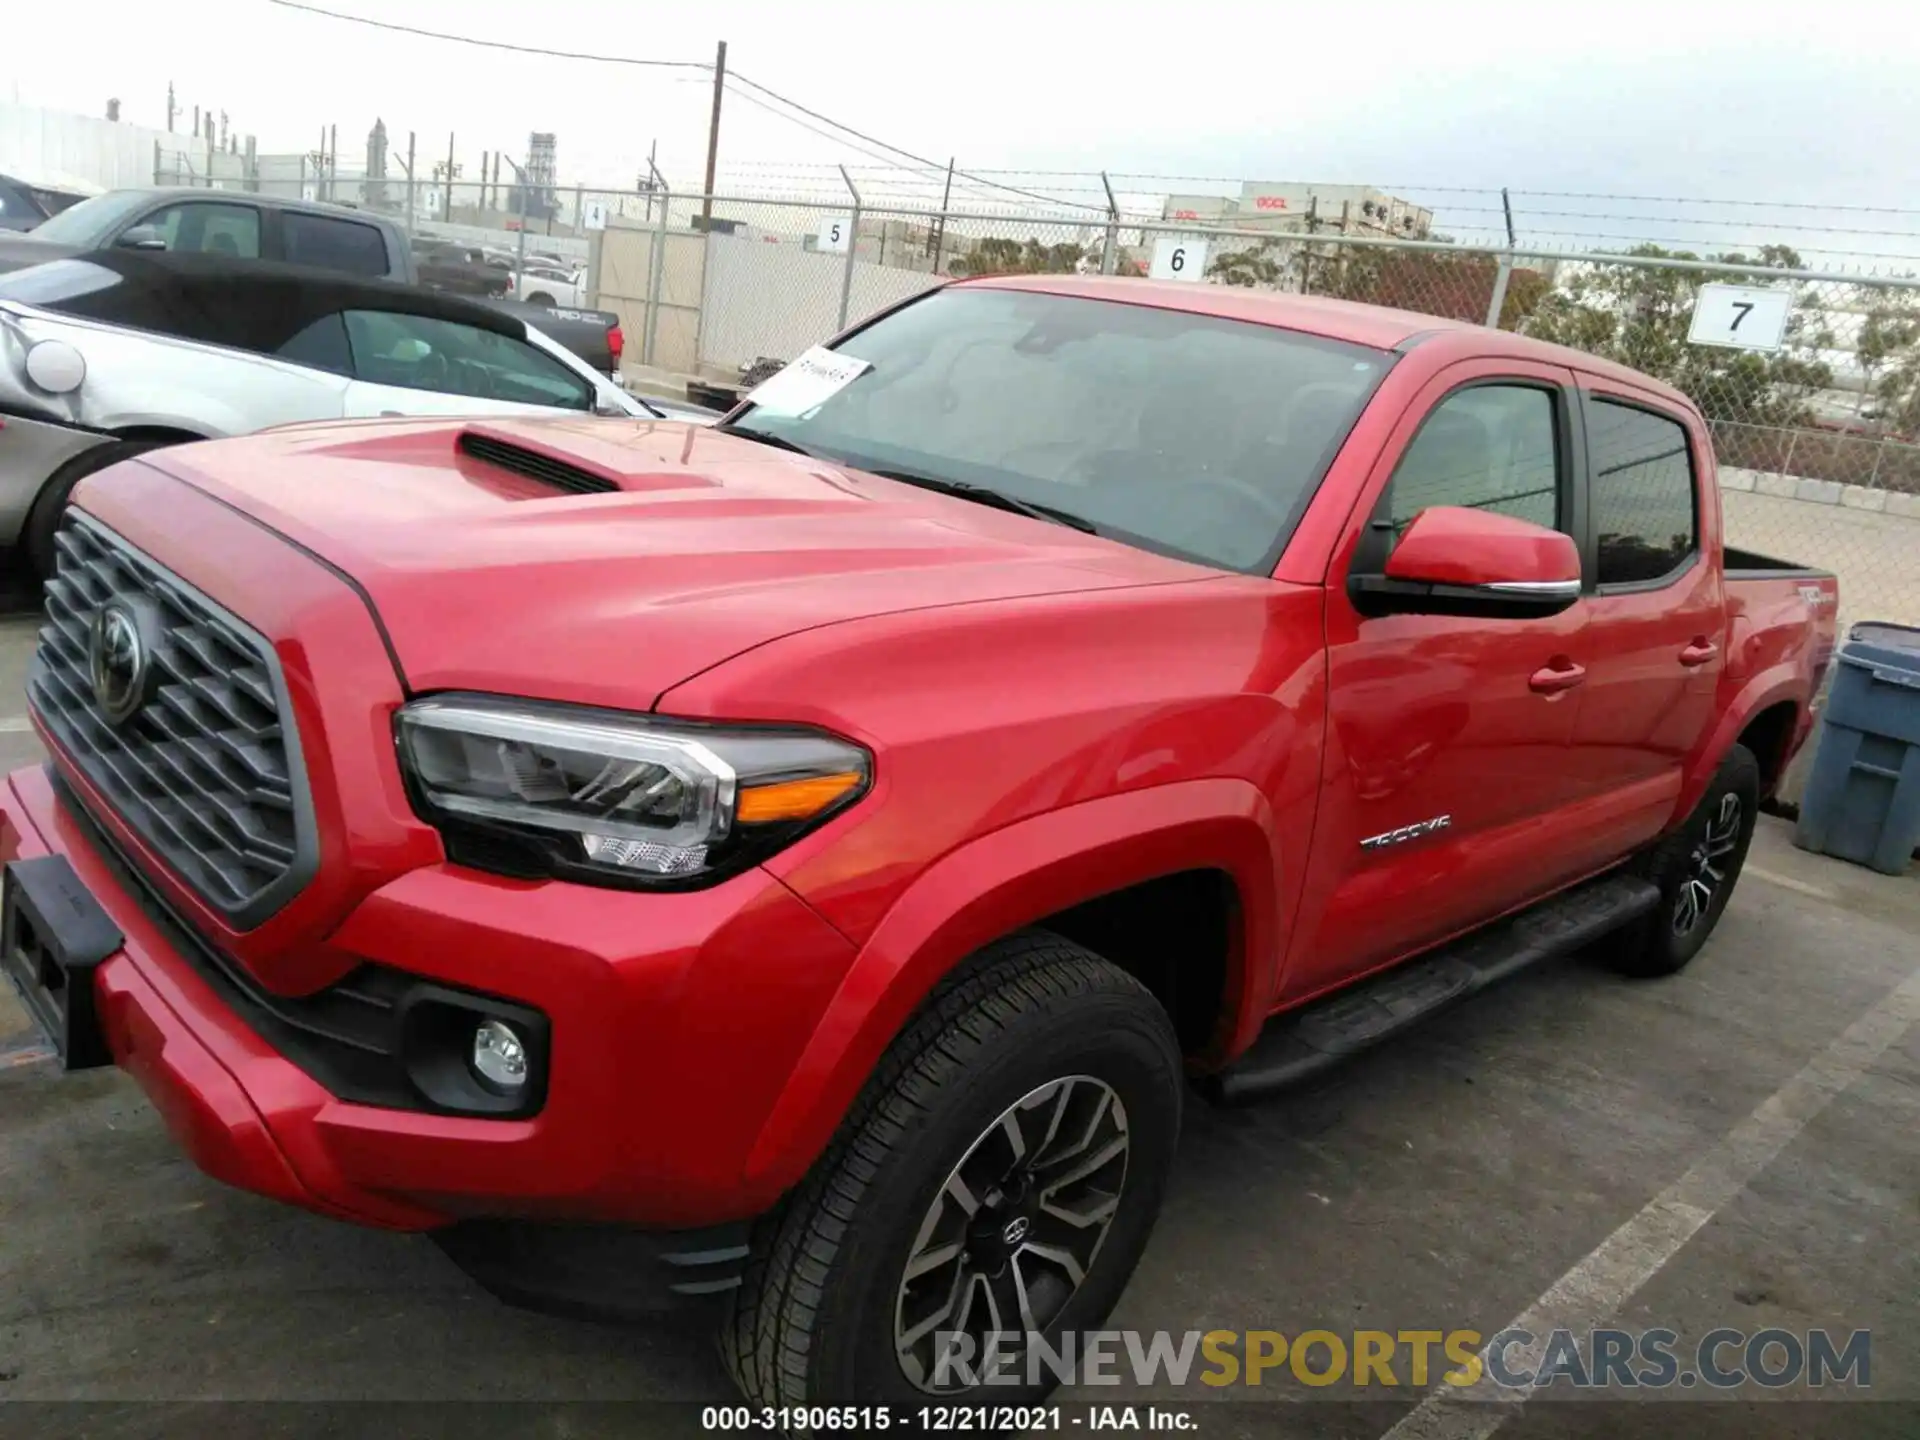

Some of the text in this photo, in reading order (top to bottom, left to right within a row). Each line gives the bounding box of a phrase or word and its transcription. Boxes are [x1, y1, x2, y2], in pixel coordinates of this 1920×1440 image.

[830, 224, 840, 242] 5
[1171, 248, 1186, 272] 6
[1730, 301, 1754, 331] 7
